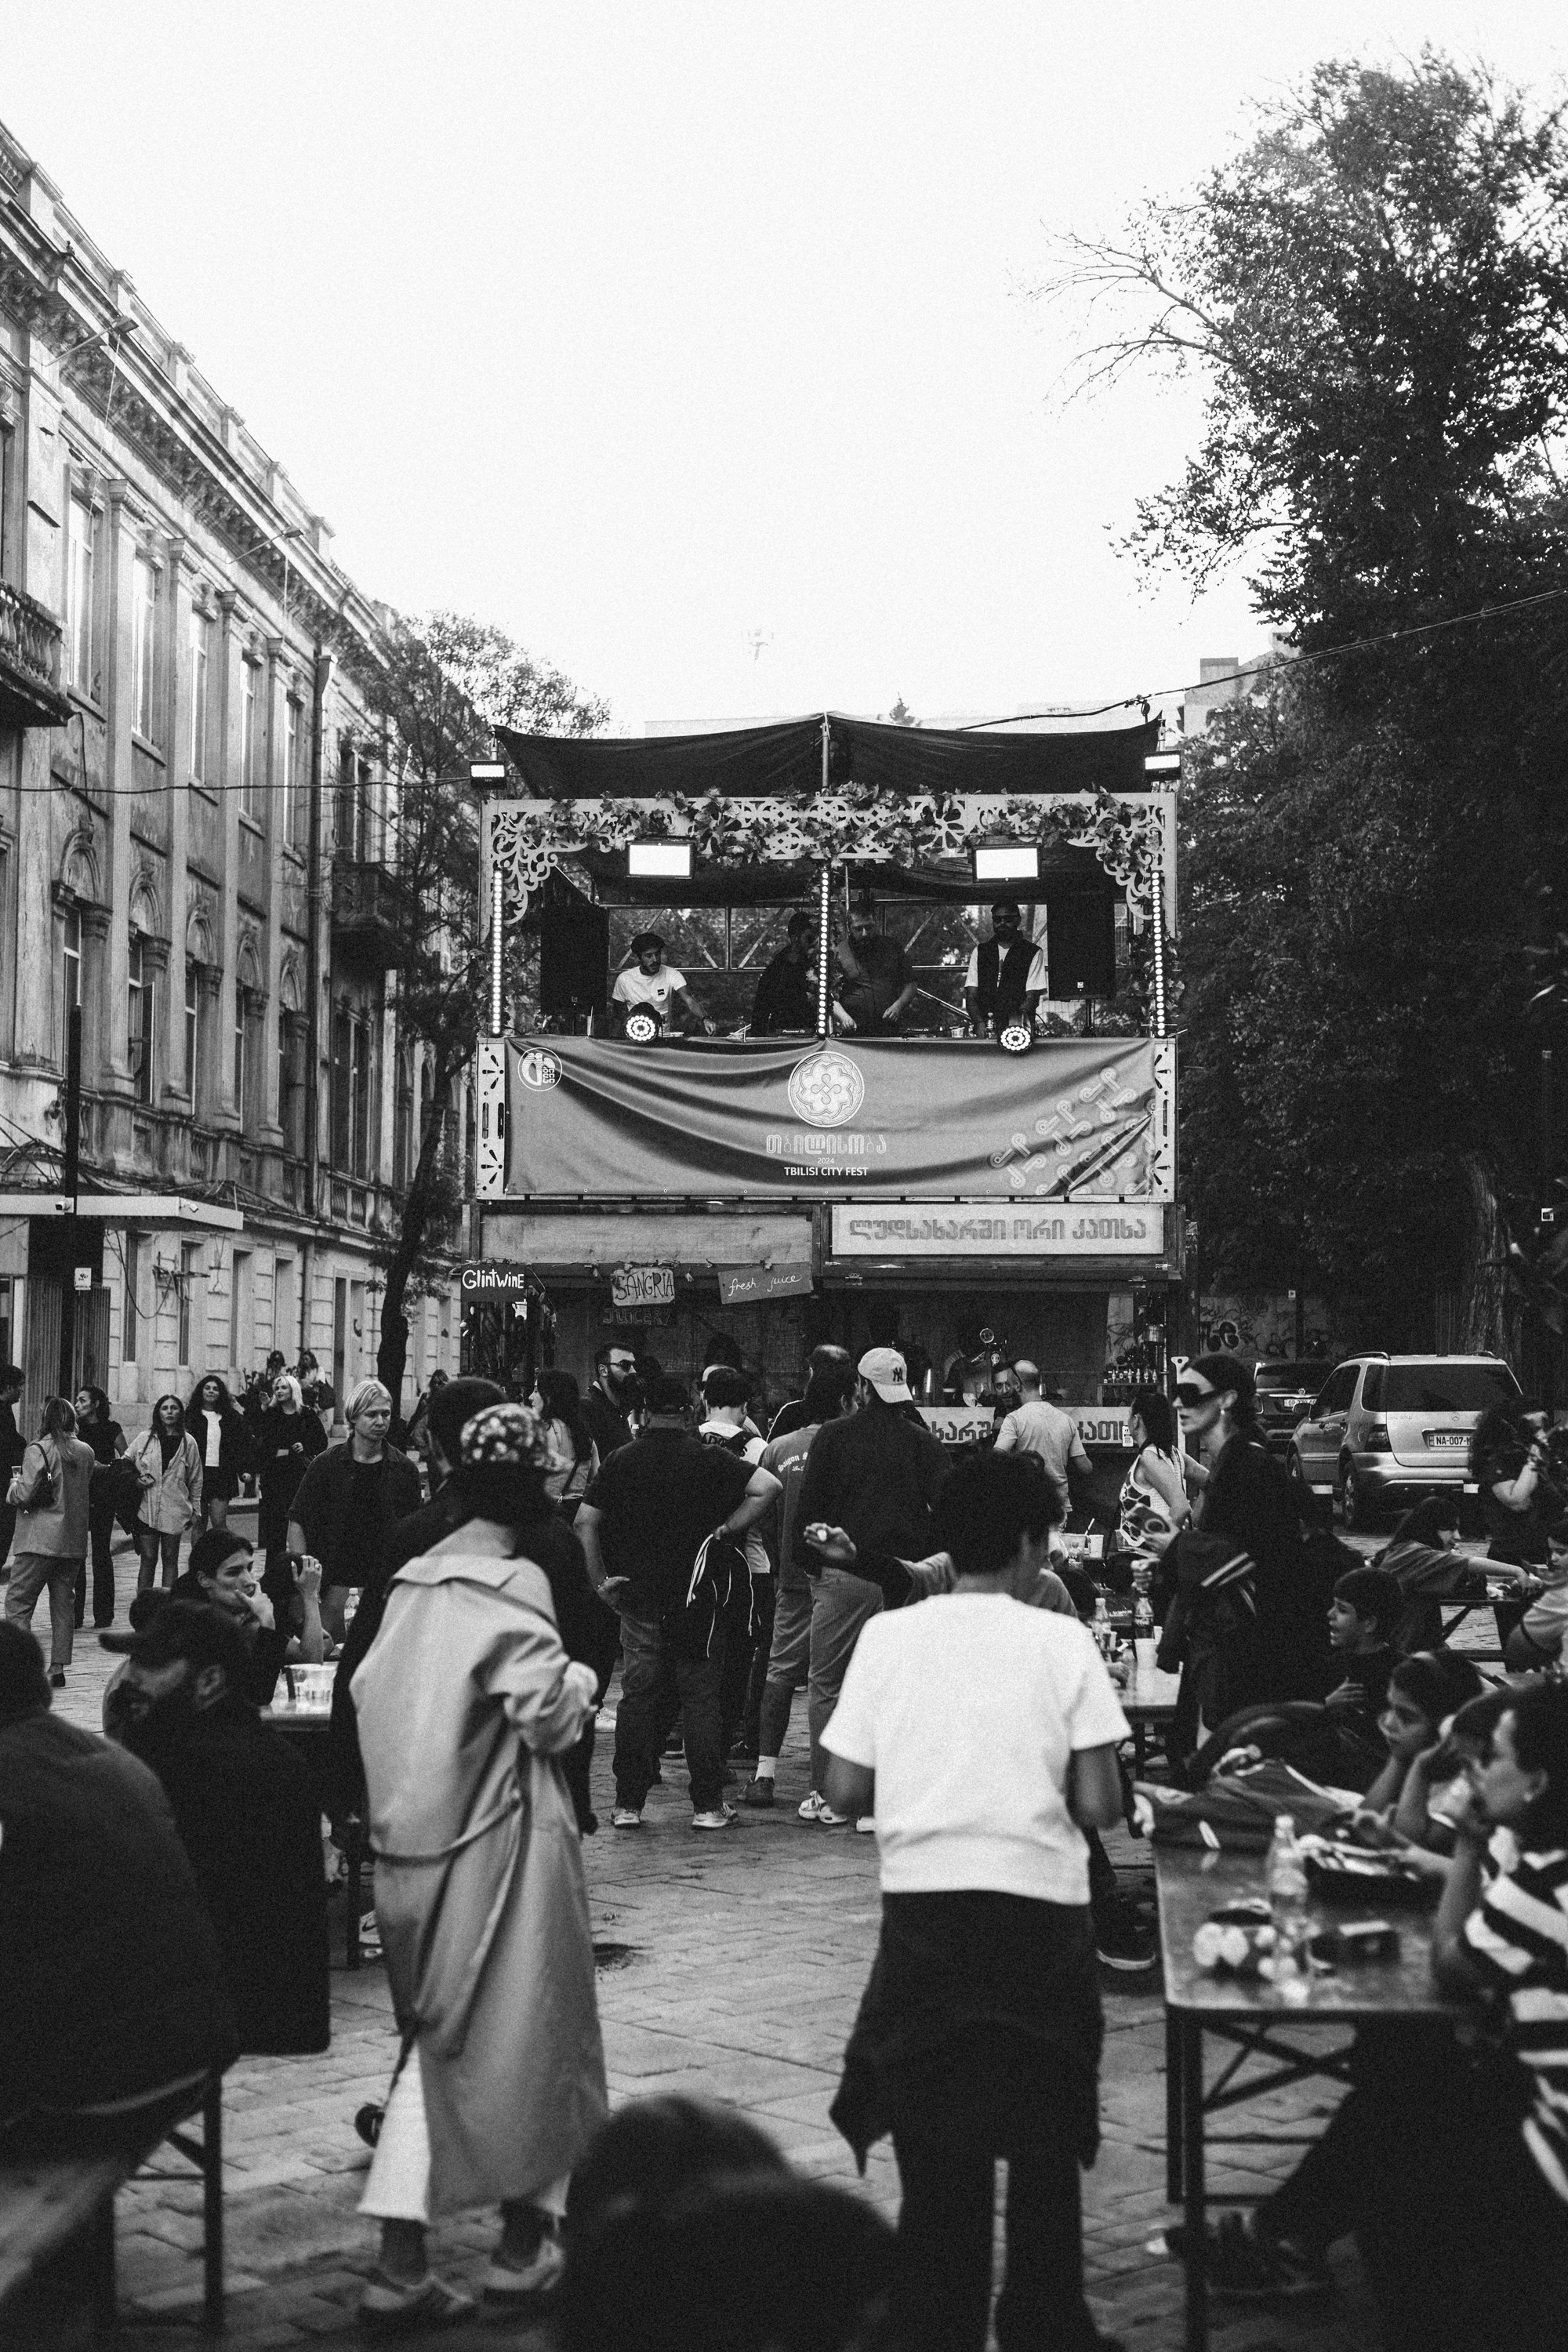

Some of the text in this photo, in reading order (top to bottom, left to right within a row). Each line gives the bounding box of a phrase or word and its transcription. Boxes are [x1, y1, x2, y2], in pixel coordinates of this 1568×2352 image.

[784, 1167, 869, 1176] TBILISI CITY FEST
[1013, 1218, 1065, 1240] ორი
[1072, 1218, 1146, 1240] კათხა
[728, 1275, 802, 1297] fresh juice
